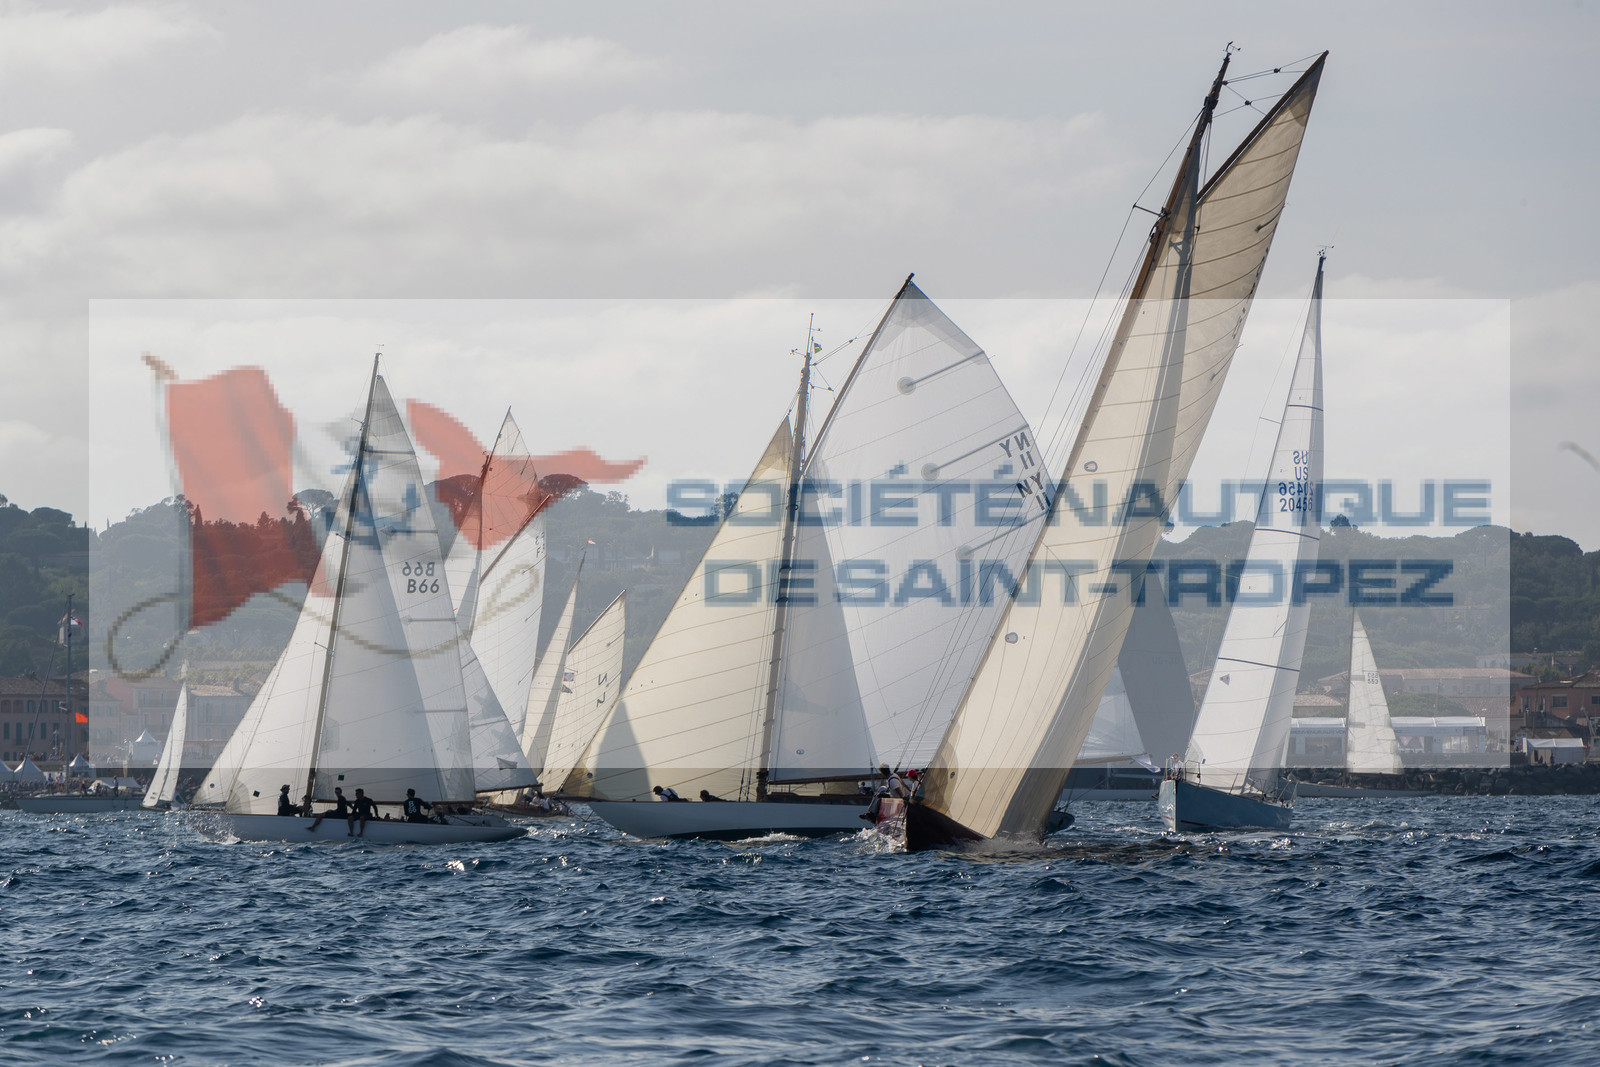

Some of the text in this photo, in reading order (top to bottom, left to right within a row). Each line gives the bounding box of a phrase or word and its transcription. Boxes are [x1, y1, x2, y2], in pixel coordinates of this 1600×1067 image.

[1294, 466, 1309, 481] US
[1016, 472, 1043, 498] NY
[1280, 497, 1313, 512] 20456
[407, 578, 440, 594] B66
